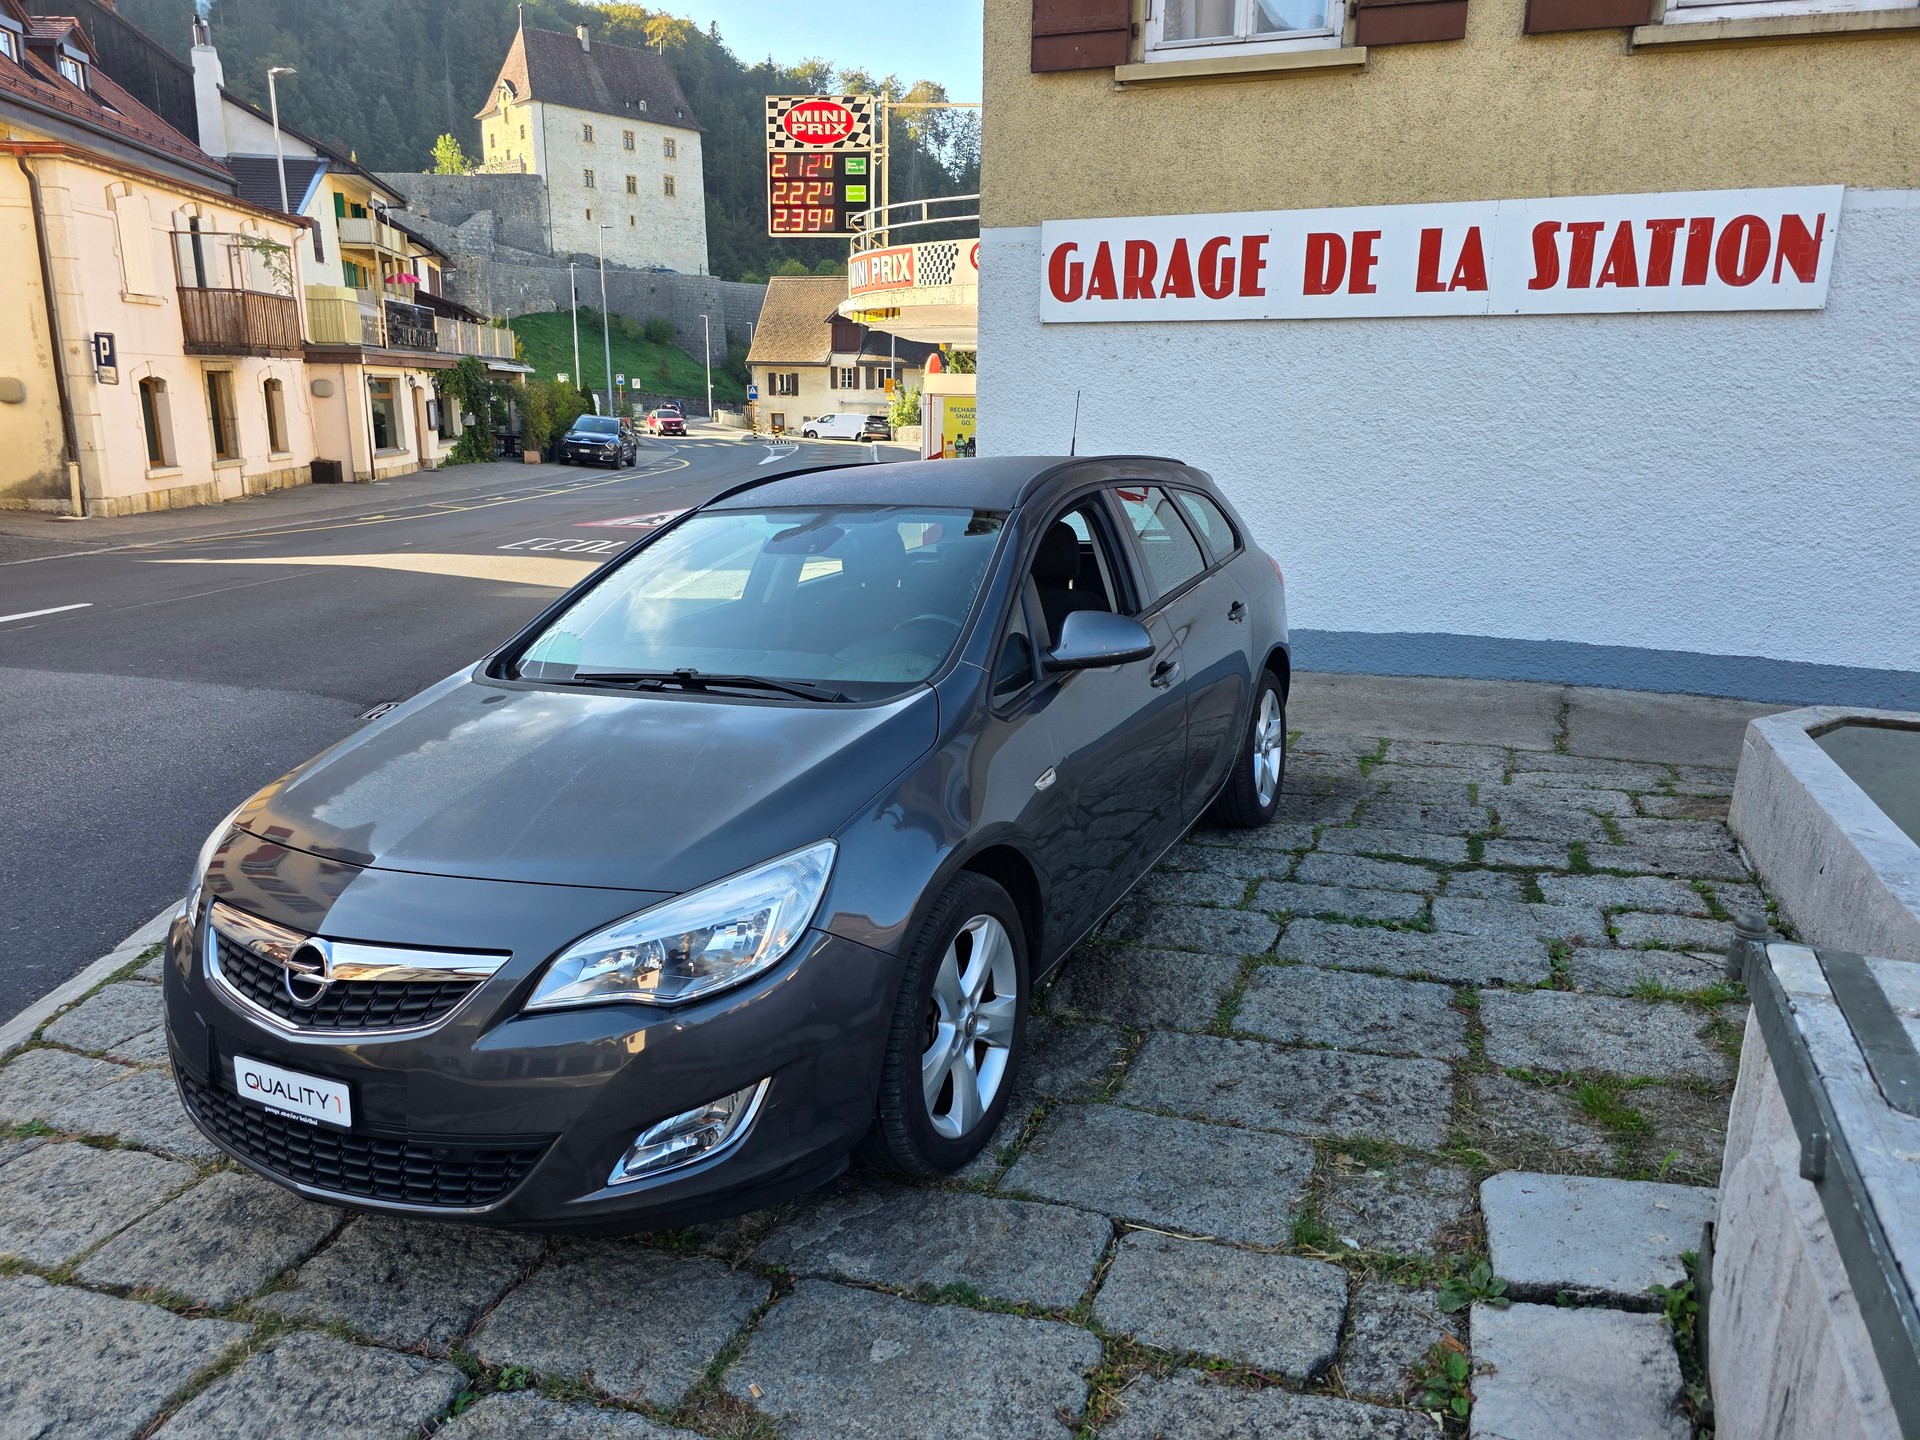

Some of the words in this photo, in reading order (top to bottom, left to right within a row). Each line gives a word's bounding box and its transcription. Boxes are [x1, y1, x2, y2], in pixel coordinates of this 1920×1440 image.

[791, 110, 847, 122] MINI
[791, 123, 847, 135] PRIX
[871, 252, 912, 286] PRIX
[1048, 234, 1270, 303] GARAGE
[1303, 230, 1382, 296] DE
[1415, 226, 1488, 293] LA
[1527, 212, 1826, 291] STATION
[99, 336, 110, 364] P
[244, 1072, 329, 1109] QUALITY
[334, 1095, 341, 1114] 1
